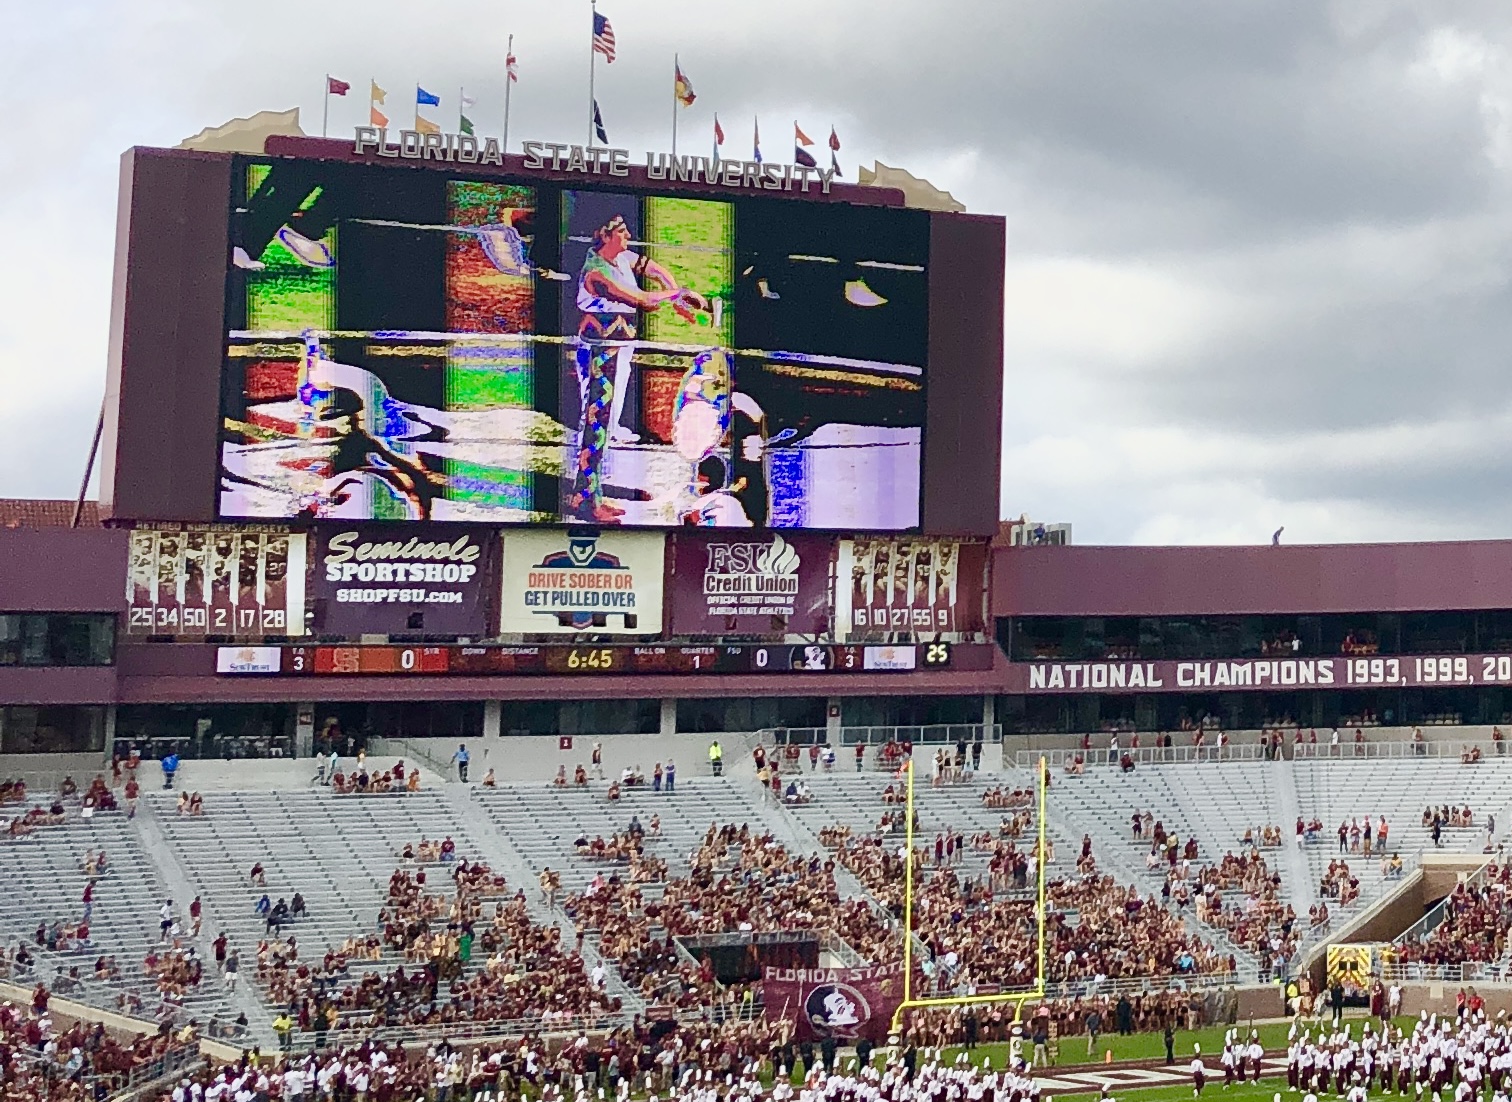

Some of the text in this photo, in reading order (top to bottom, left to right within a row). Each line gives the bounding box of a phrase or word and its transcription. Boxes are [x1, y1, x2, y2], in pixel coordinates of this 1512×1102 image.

[354, 127, 835, 193] FLORIDA STATE UNIVERSITY
[324, 531, 480, 564] Seminole
[705, 542, 775, 574] FSU
[325, 562, 476, 582] SPORTSHOP
[528, 572, 633, 589] DRIVE SOBER OR
[706, 575, 797, 592] Credit Union
[525, 591, 636, 607] GET PULLED OVER
[131, 607, 285, 628] 25 34 50 2 17 28
[854, 608, 948, 625] 16 10 27 55 9
[401, 649, 415, 669] 0
[567, 649, 613, 669] 6:45
[693, 655, 700, 669] 1
[756, 648, 768, 667] 0
[845, 654, 854, 668] 3
[926, 644, 948, 663] 25
[293, 656, 304, 671] 3
[1029, 663, 1162, 689] NATIONAL
[1176, 659, 1334, 686] CHAMPIONS
[1347, 658, 1407, 685] 1993,
[1415, 657, 1475, 684] 1999,
[765, 959, 907, 983] FLORIDA STATE
